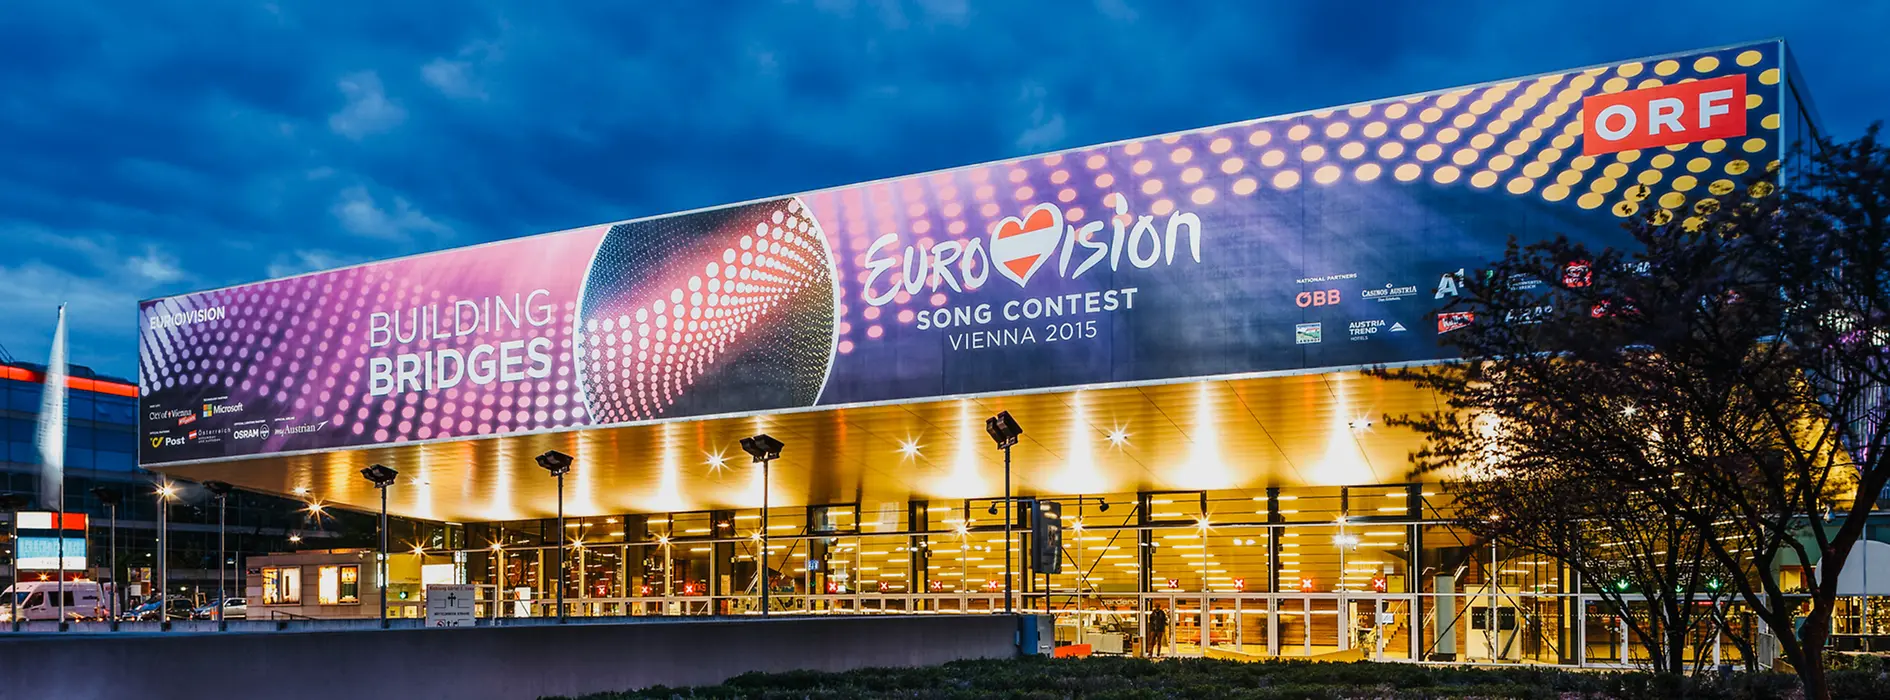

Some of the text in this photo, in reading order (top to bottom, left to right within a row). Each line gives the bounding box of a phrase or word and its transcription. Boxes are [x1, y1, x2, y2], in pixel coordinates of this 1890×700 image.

[1595, 89, 1733, 141] ORF
[1296, 273, 1358, 284] NATIONAL PARTNERS
[1361, 285, 1417, 298] CASINOS AUSTRIA
[916, 287, 1138, 330] SONG CONTEST
[150, 305, 226, 330] EUR(O)VISION
[370, 289, 552, 348] BUILDING
[1349, 319, 1386, 329] AUSTRIA
[949, 320, 1098, 351] VIENNA 2015
[1349, 327, 1378, 336] TREND
[369, 336, 553, 397] BRIDGES
[213, 402, 243, 414] Microsoft
[233, 428, 259, 440] OSRAM
[165, 436, 186, 447] Post
